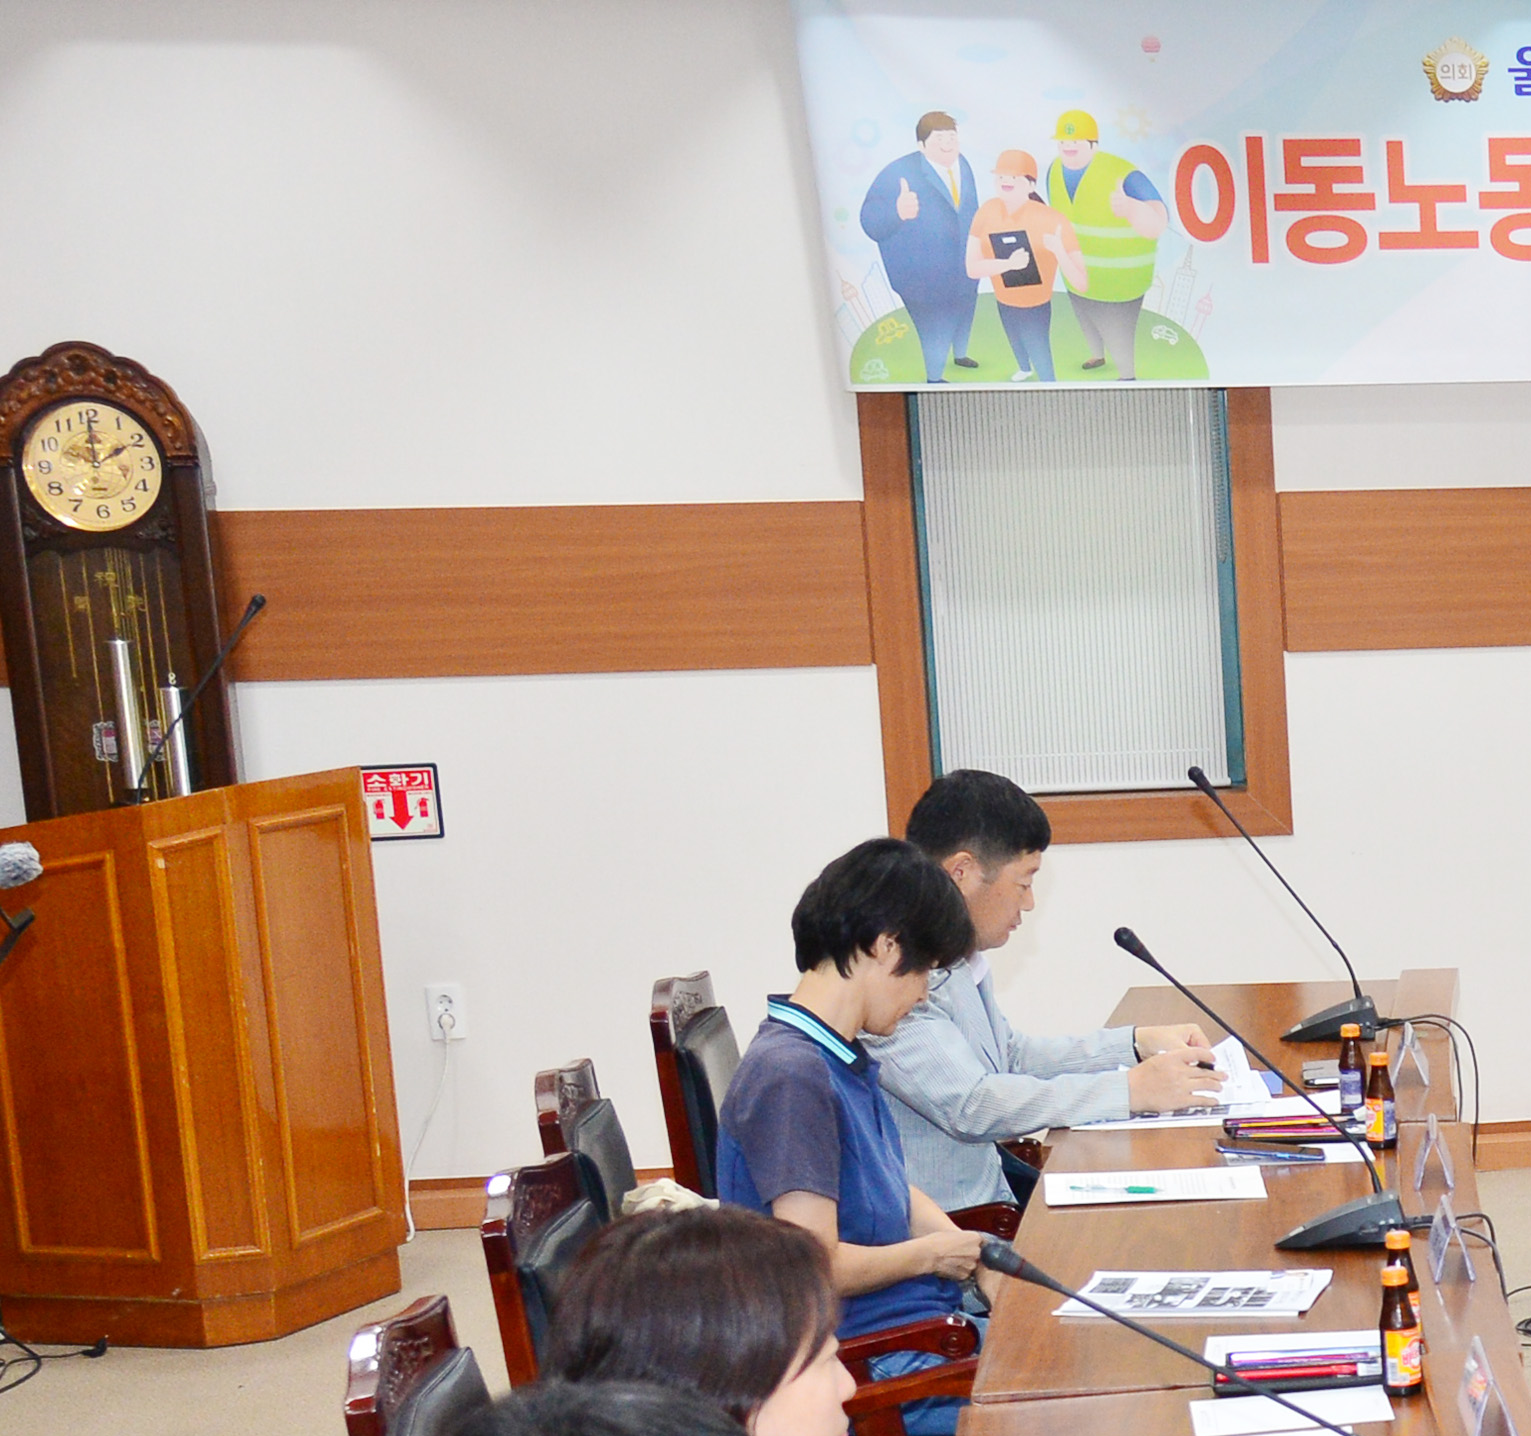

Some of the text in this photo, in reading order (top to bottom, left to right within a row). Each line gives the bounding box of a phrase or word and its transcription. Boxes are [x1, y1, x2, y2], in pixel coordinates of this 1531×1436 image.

[1440, 64, 1472, 80] 의회
[78, 409, 98, 424] 12
[115, 416, 122, 430] 1
[55, 418, 72, 433] 11
[41, 437, 58, 452] 10
[129, 433, 144, 448] 2
[38, 460, 52, 475] 9
[140, 456, 155, 471] 3
[47, 481, 63, 496] 8
[134, 478, 150, 492] 4
[68, 498, 83, 513] 7
[96, 504, 111, 519] 6
[121, 497, 136, 512] 5
[367, 772, 429, 788] 소화기
